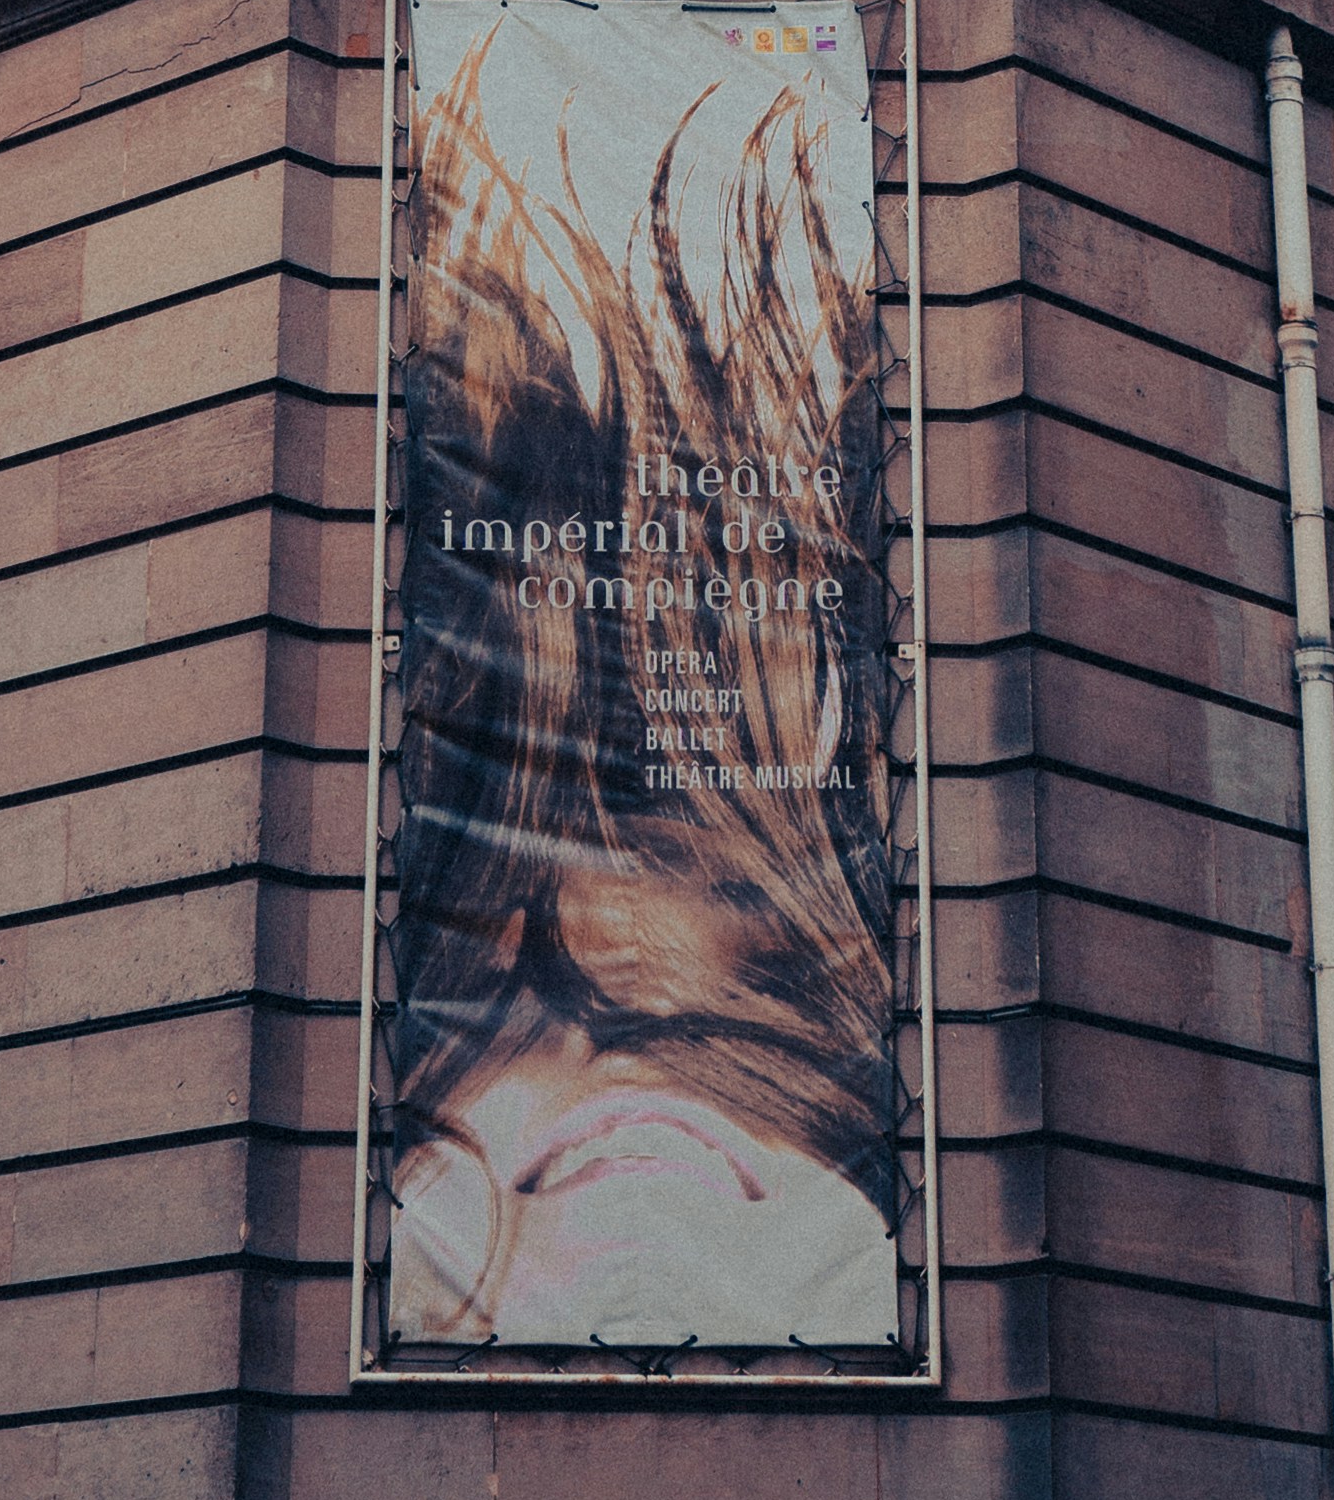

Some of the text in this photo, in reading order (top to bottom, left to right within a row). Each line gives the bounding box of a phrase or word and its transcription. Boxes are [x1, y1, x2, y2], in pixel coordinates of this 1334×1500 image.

[634, 452, 842, 499] théâtre
[440, 508, 787, 563] impérial de
[517, 567, 845, 622] compiègne
[644, 646, 718, 675] OPÉRA
[644, 689, 743, 714] CONCERT
[644, 727, 727, 752] BALLET
[644, 760, 856, 790] THÉÂTRE MUSICAL
